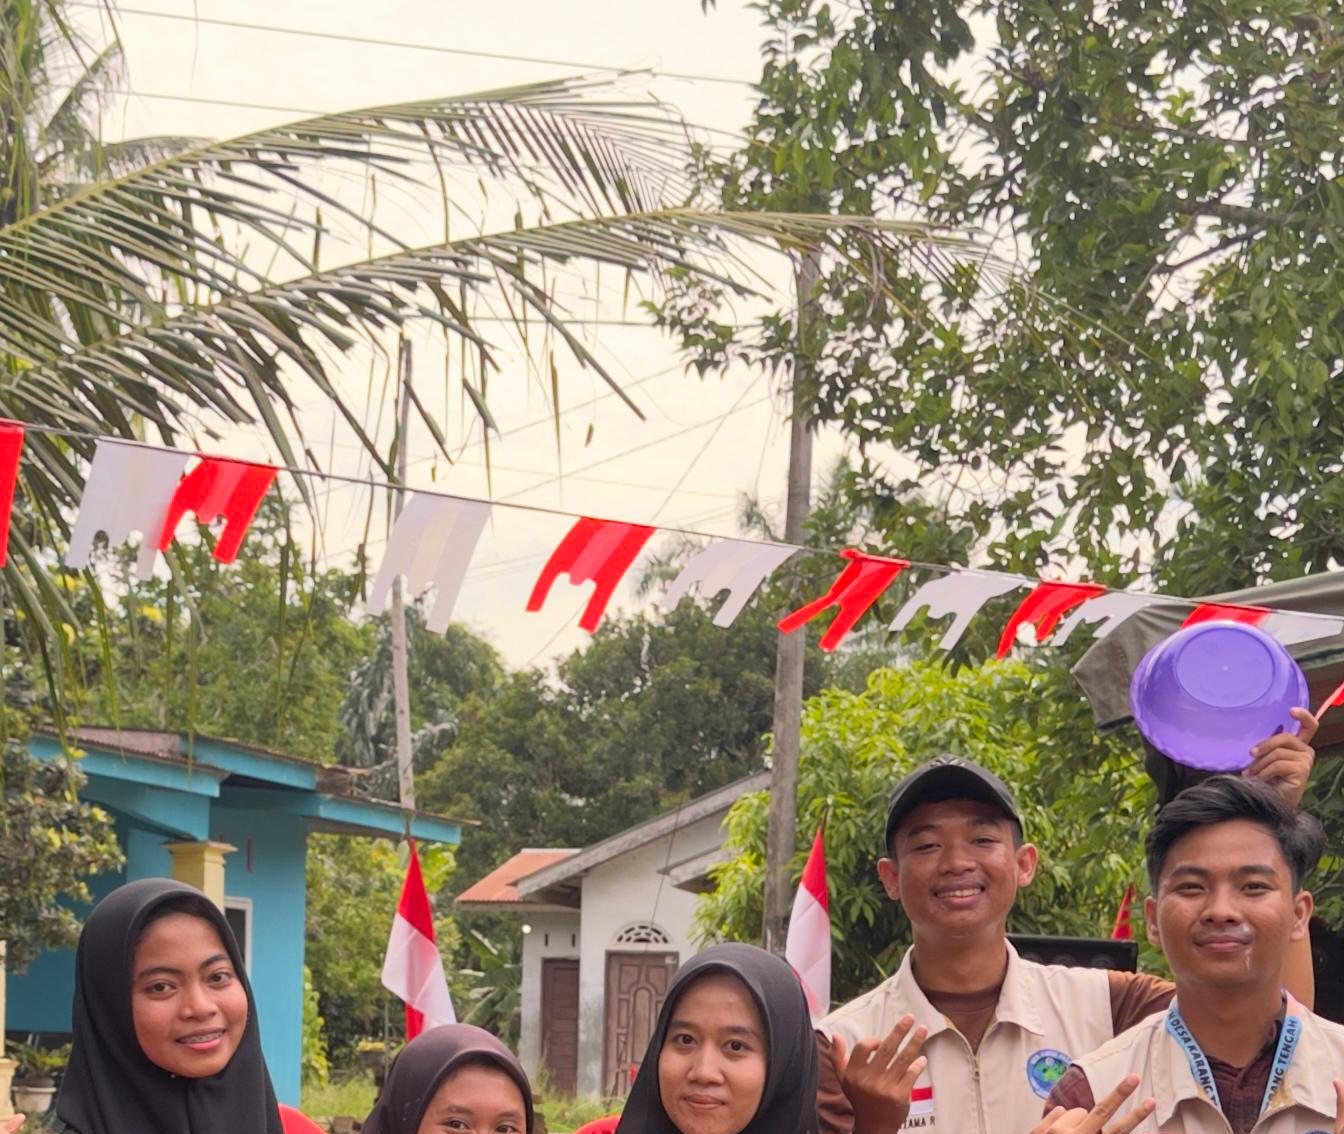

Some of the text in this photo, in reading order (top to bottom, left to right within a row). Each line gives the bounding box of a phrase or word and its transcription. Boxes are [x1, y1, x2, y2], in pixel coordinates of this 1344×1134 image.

[1170, 1018, 1191, 1044] DESA
[1188, 1043, 1215, 1095] KARANG
[1278, 1018, 1298, 1066] TENGAH
